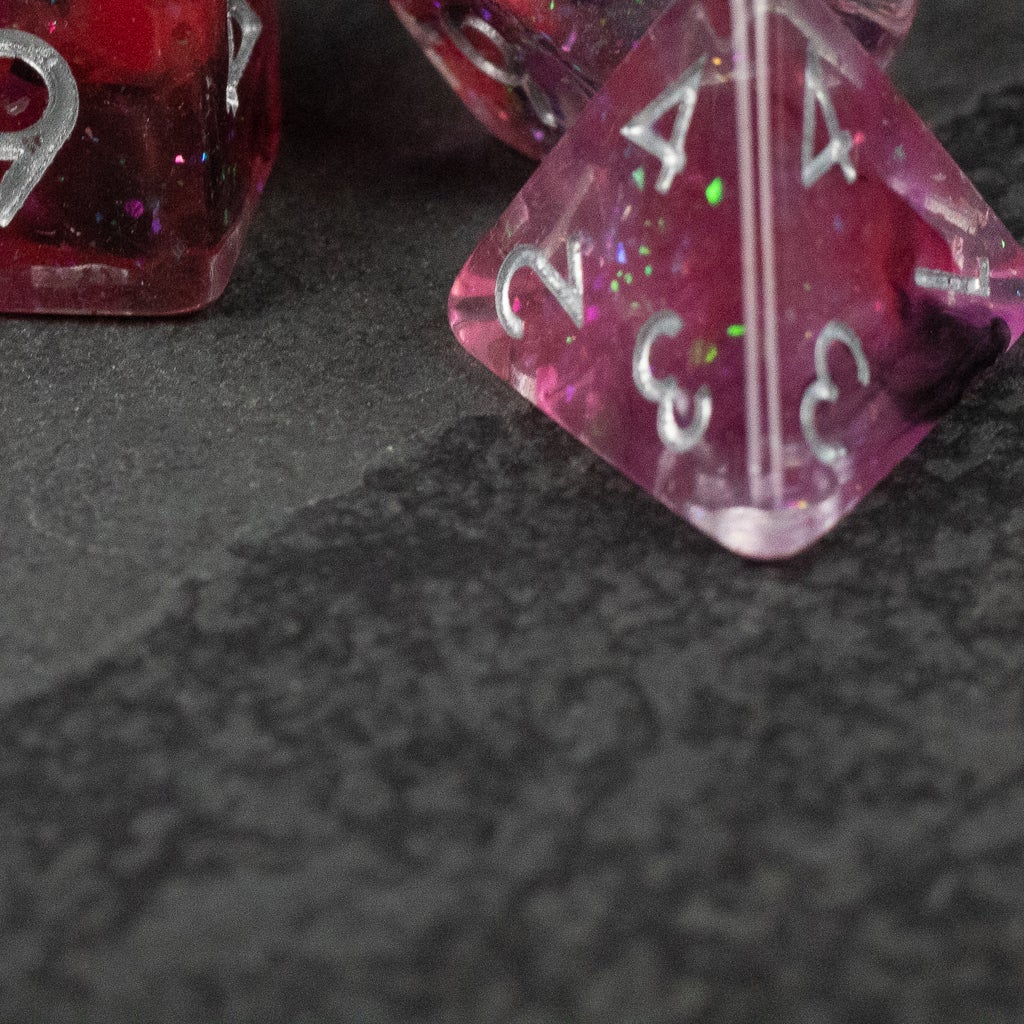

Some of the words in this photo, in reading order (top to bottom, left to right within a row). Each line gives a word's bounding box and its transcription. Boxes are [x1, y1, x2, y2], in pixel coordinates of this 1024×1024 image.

[619, 52, 708, 195] 4
[801, 41, 857, 189] 4
[495, 232, 584, 340] 2
[632, 309, 713, 453] 3
[799, 319, 871, 463] 3
